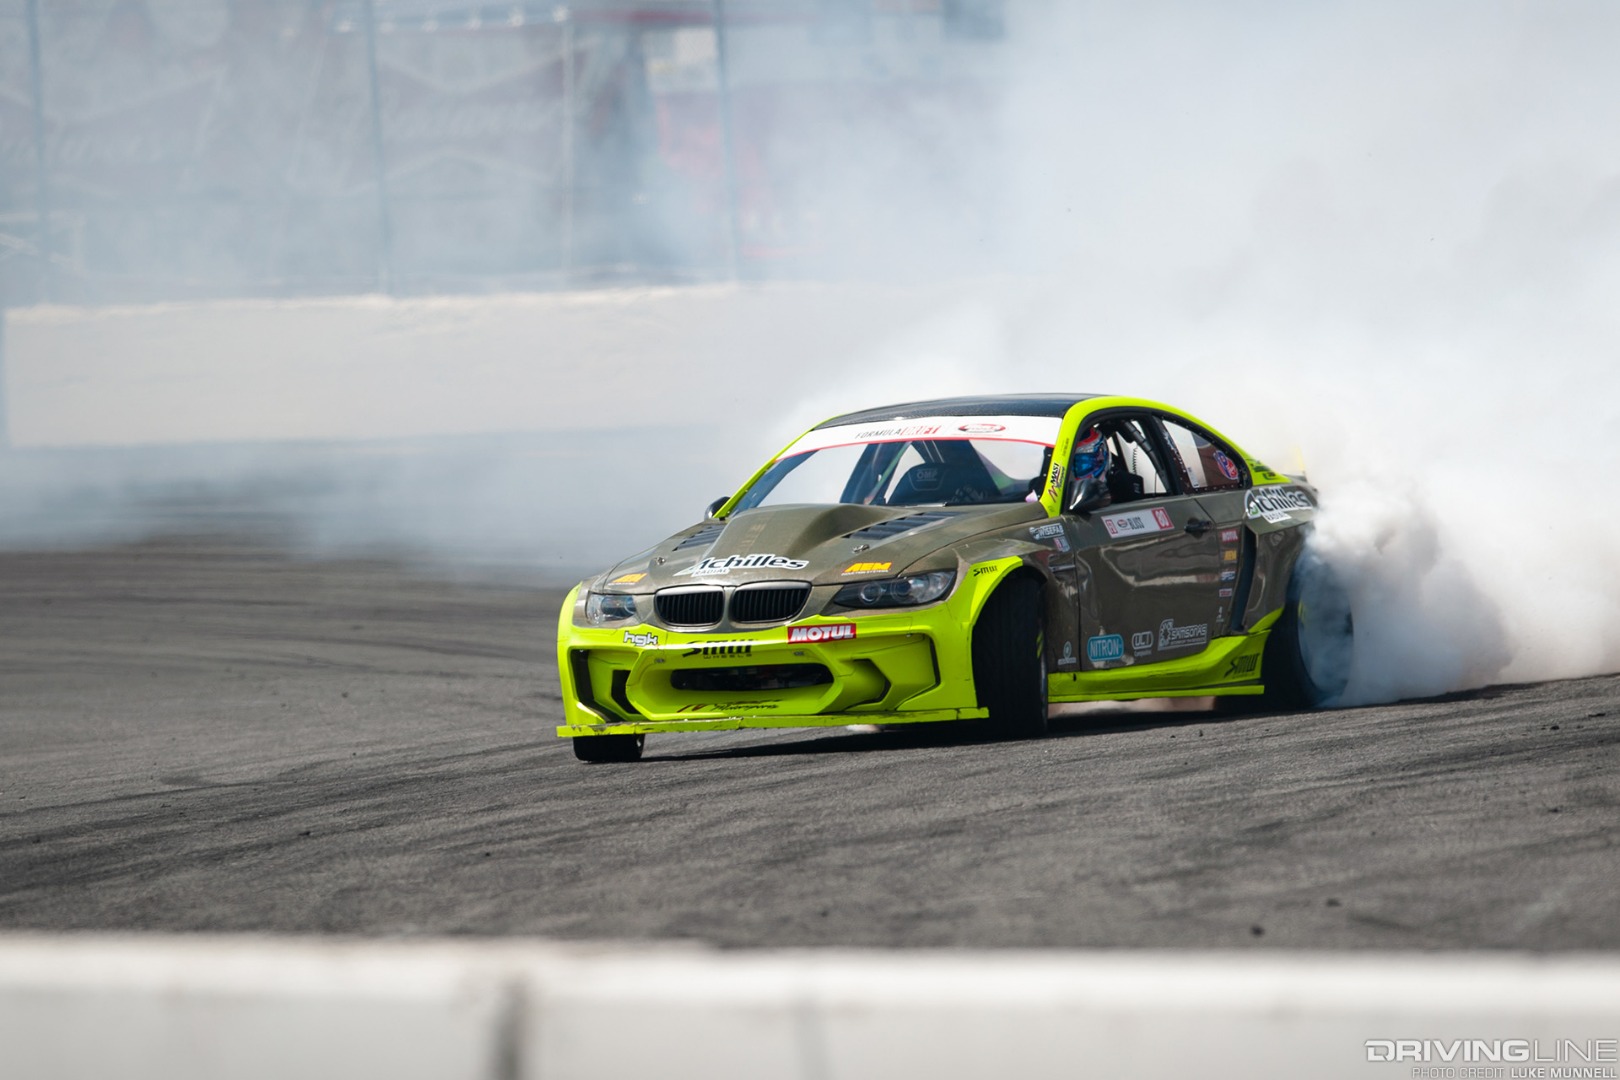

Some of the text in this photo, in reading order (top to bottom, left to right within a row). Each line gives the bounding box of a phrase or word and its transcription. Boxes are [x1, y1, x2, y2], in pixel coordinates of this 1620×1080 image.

[674, 554, 809, 577] Achilles
[844, 561, 893, 573] AEM
[623, 630, 659, 647] hgk
[790, 625, 854, 642] MOTUL
[1090, 638, 1120, 658] NITRON
